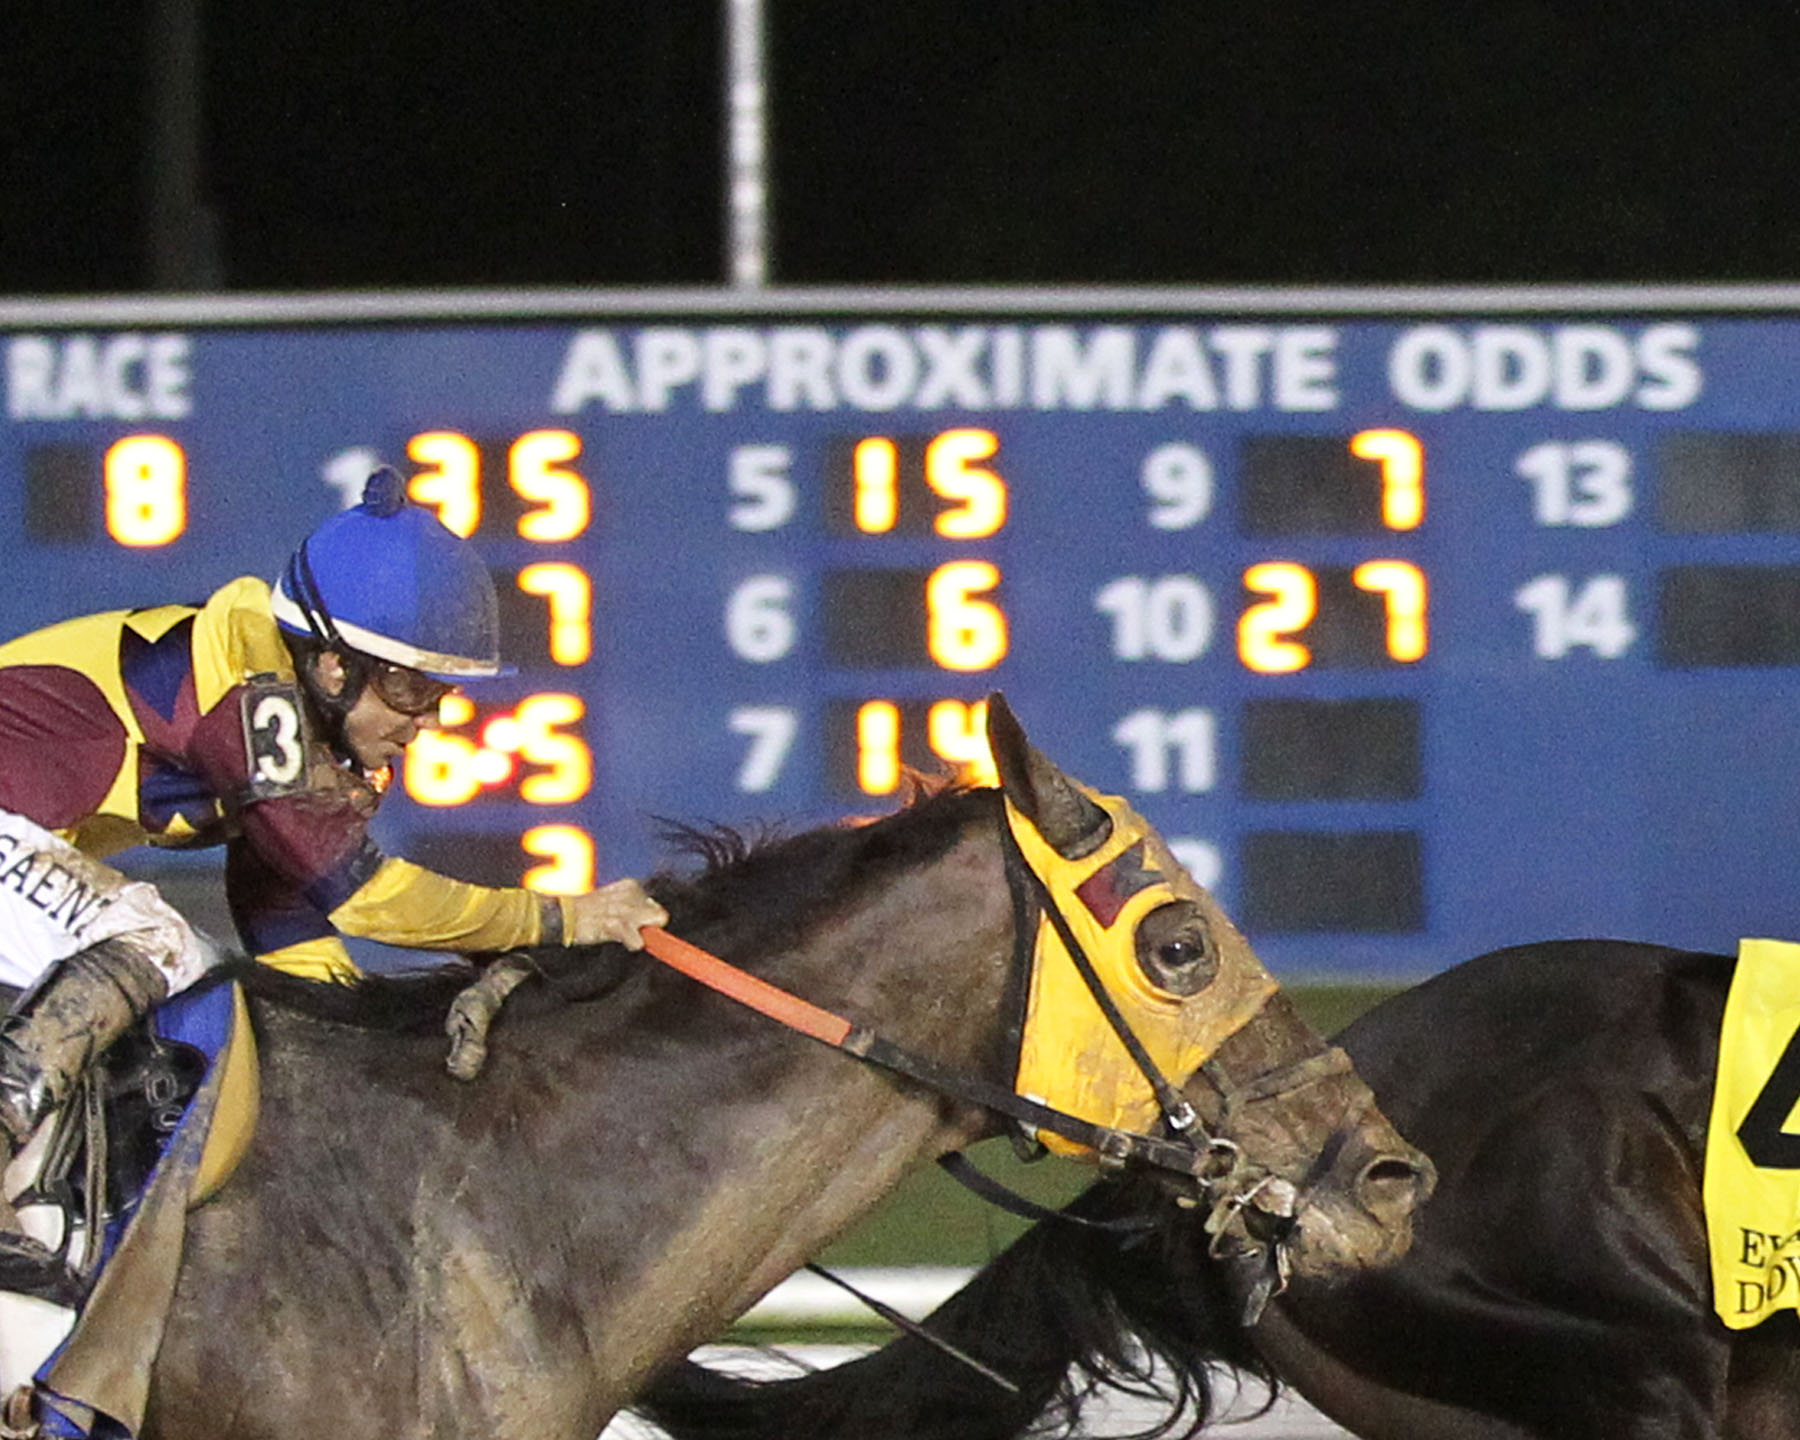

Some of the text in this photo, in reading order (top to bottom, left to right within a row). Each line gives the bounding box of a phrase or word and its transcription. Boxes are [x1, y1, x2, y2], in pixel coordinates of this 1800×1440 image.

[5, 333, 193, 420] RACE
[552, 324, 1704, 414] APPROXIMATE ODDS
[103, 433, 189, 548] 8
[728, 443, 795, 532] 5
[1141, 441, 1213, 531] 9
[1348, 427, 1426, 532] 7
[1517, 438, 1633, 527] 13
[517, 561, 592, 667] 7
[727, 575, 795, 663] 6
[926, 560, 1010, 672] 6
[1096, 574, 1215, 662] 10
[1516, 574, 1634, 660] 14
[252, 696, 303, 784] 3
[728, 706, 796, 792] 7
[1114, 708, 1216, 793] 11
[0, 832, 111, 938] AEN
